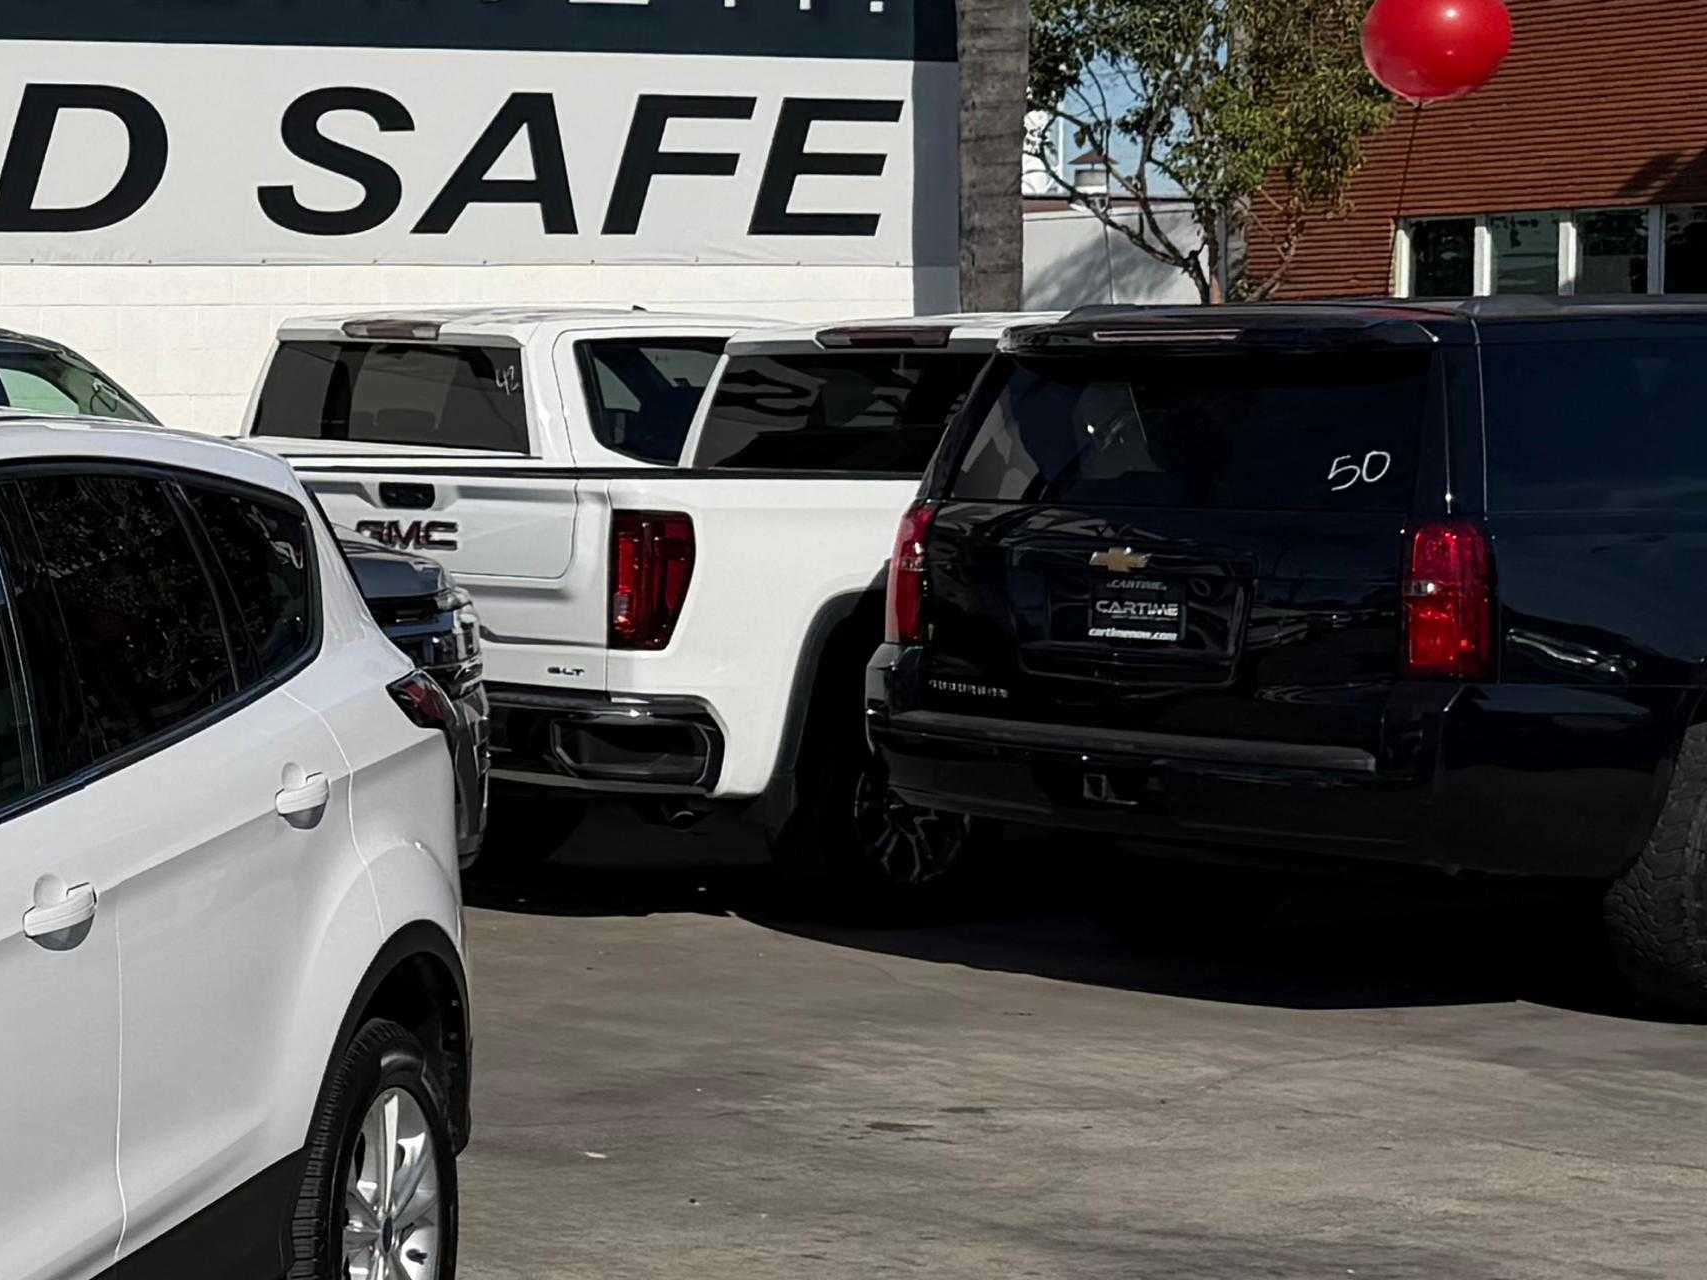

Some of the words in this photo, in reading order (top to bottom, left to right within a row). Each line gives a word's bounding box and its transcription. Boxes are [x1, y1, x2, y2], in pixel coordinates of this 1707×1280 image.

[257, 86, 904, 237] SAFE
[1327, 450, 1391, 491] 50
[1095, 600, 1179, 617] CARTIME
